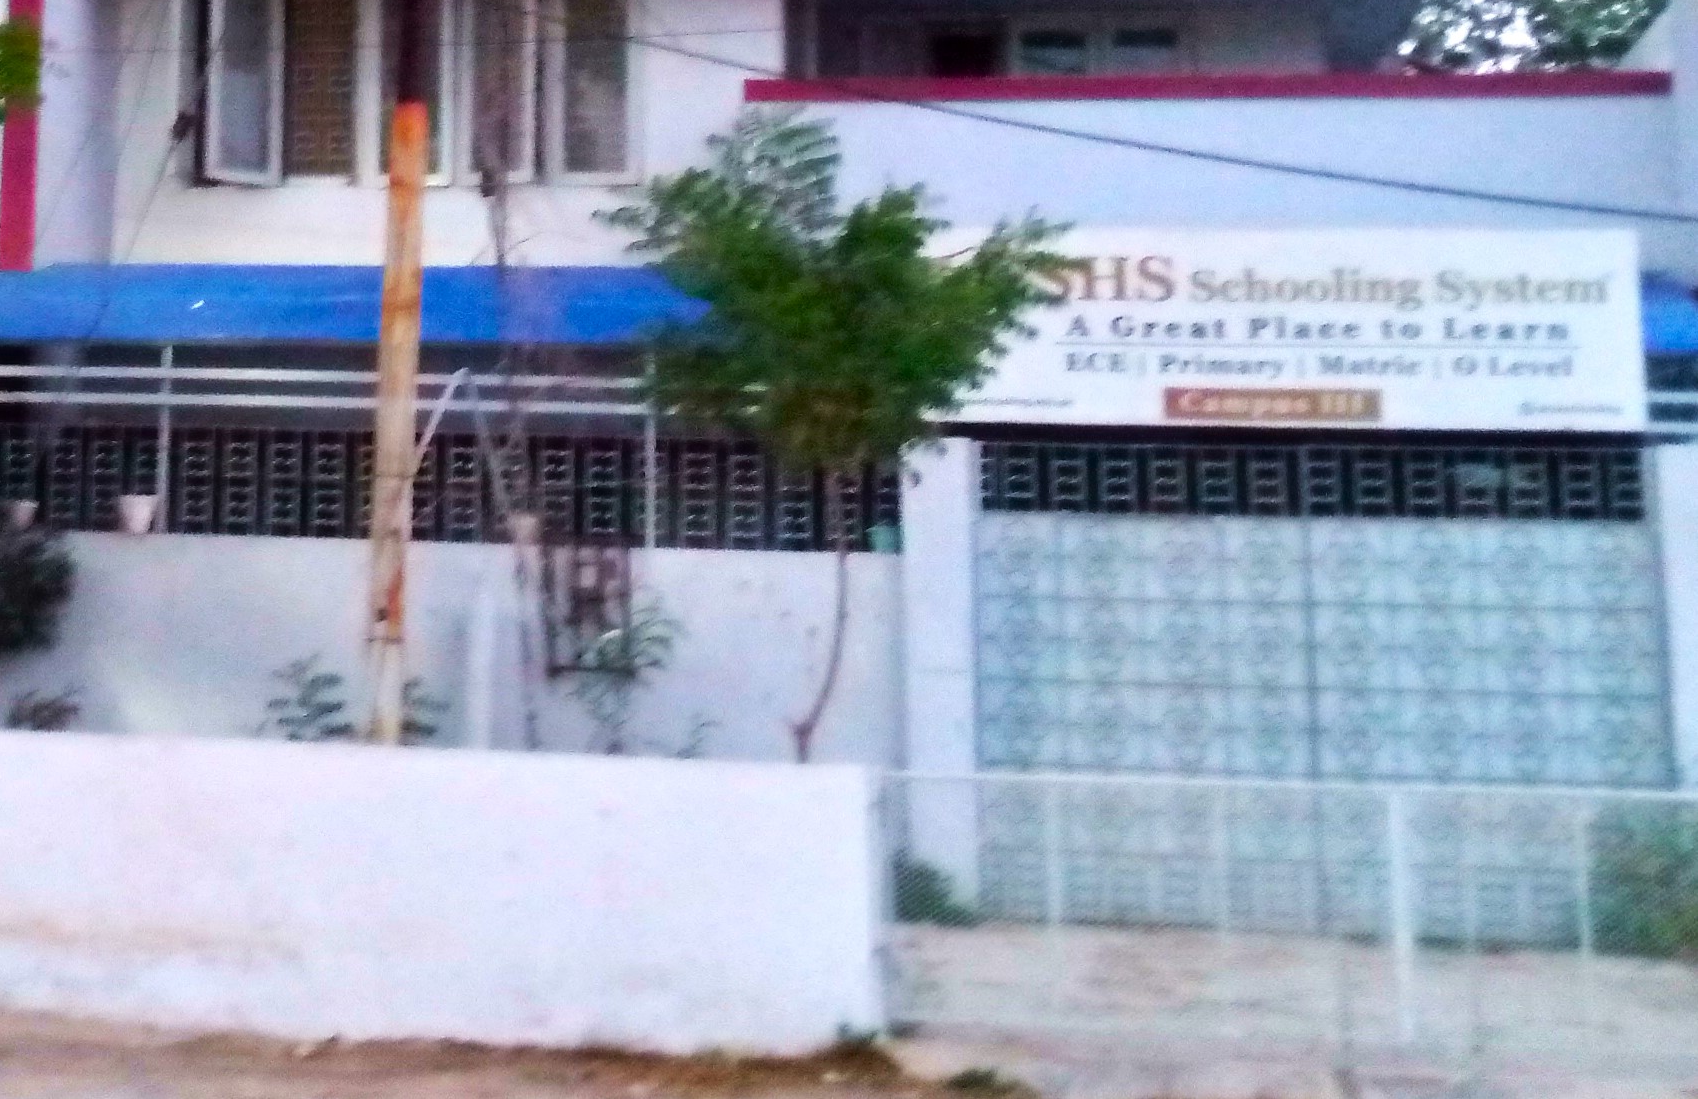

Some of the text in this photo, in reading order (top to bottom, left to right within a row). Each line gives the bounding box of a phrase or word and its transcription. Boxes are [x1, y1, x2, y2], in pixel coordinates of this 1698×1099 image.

[1188, 267, 1423, 312] Schooling
[1433, 268, 1610, 312] System
[1064, 314, 1570, 342] A Great Place to Learn
[1064, 351, 1128, 374] ECE
[1157, 352, 1287, 380] Primary
[1316, 354, 1422, 377] Matric
[1488, 355, 1574, 379] Level
